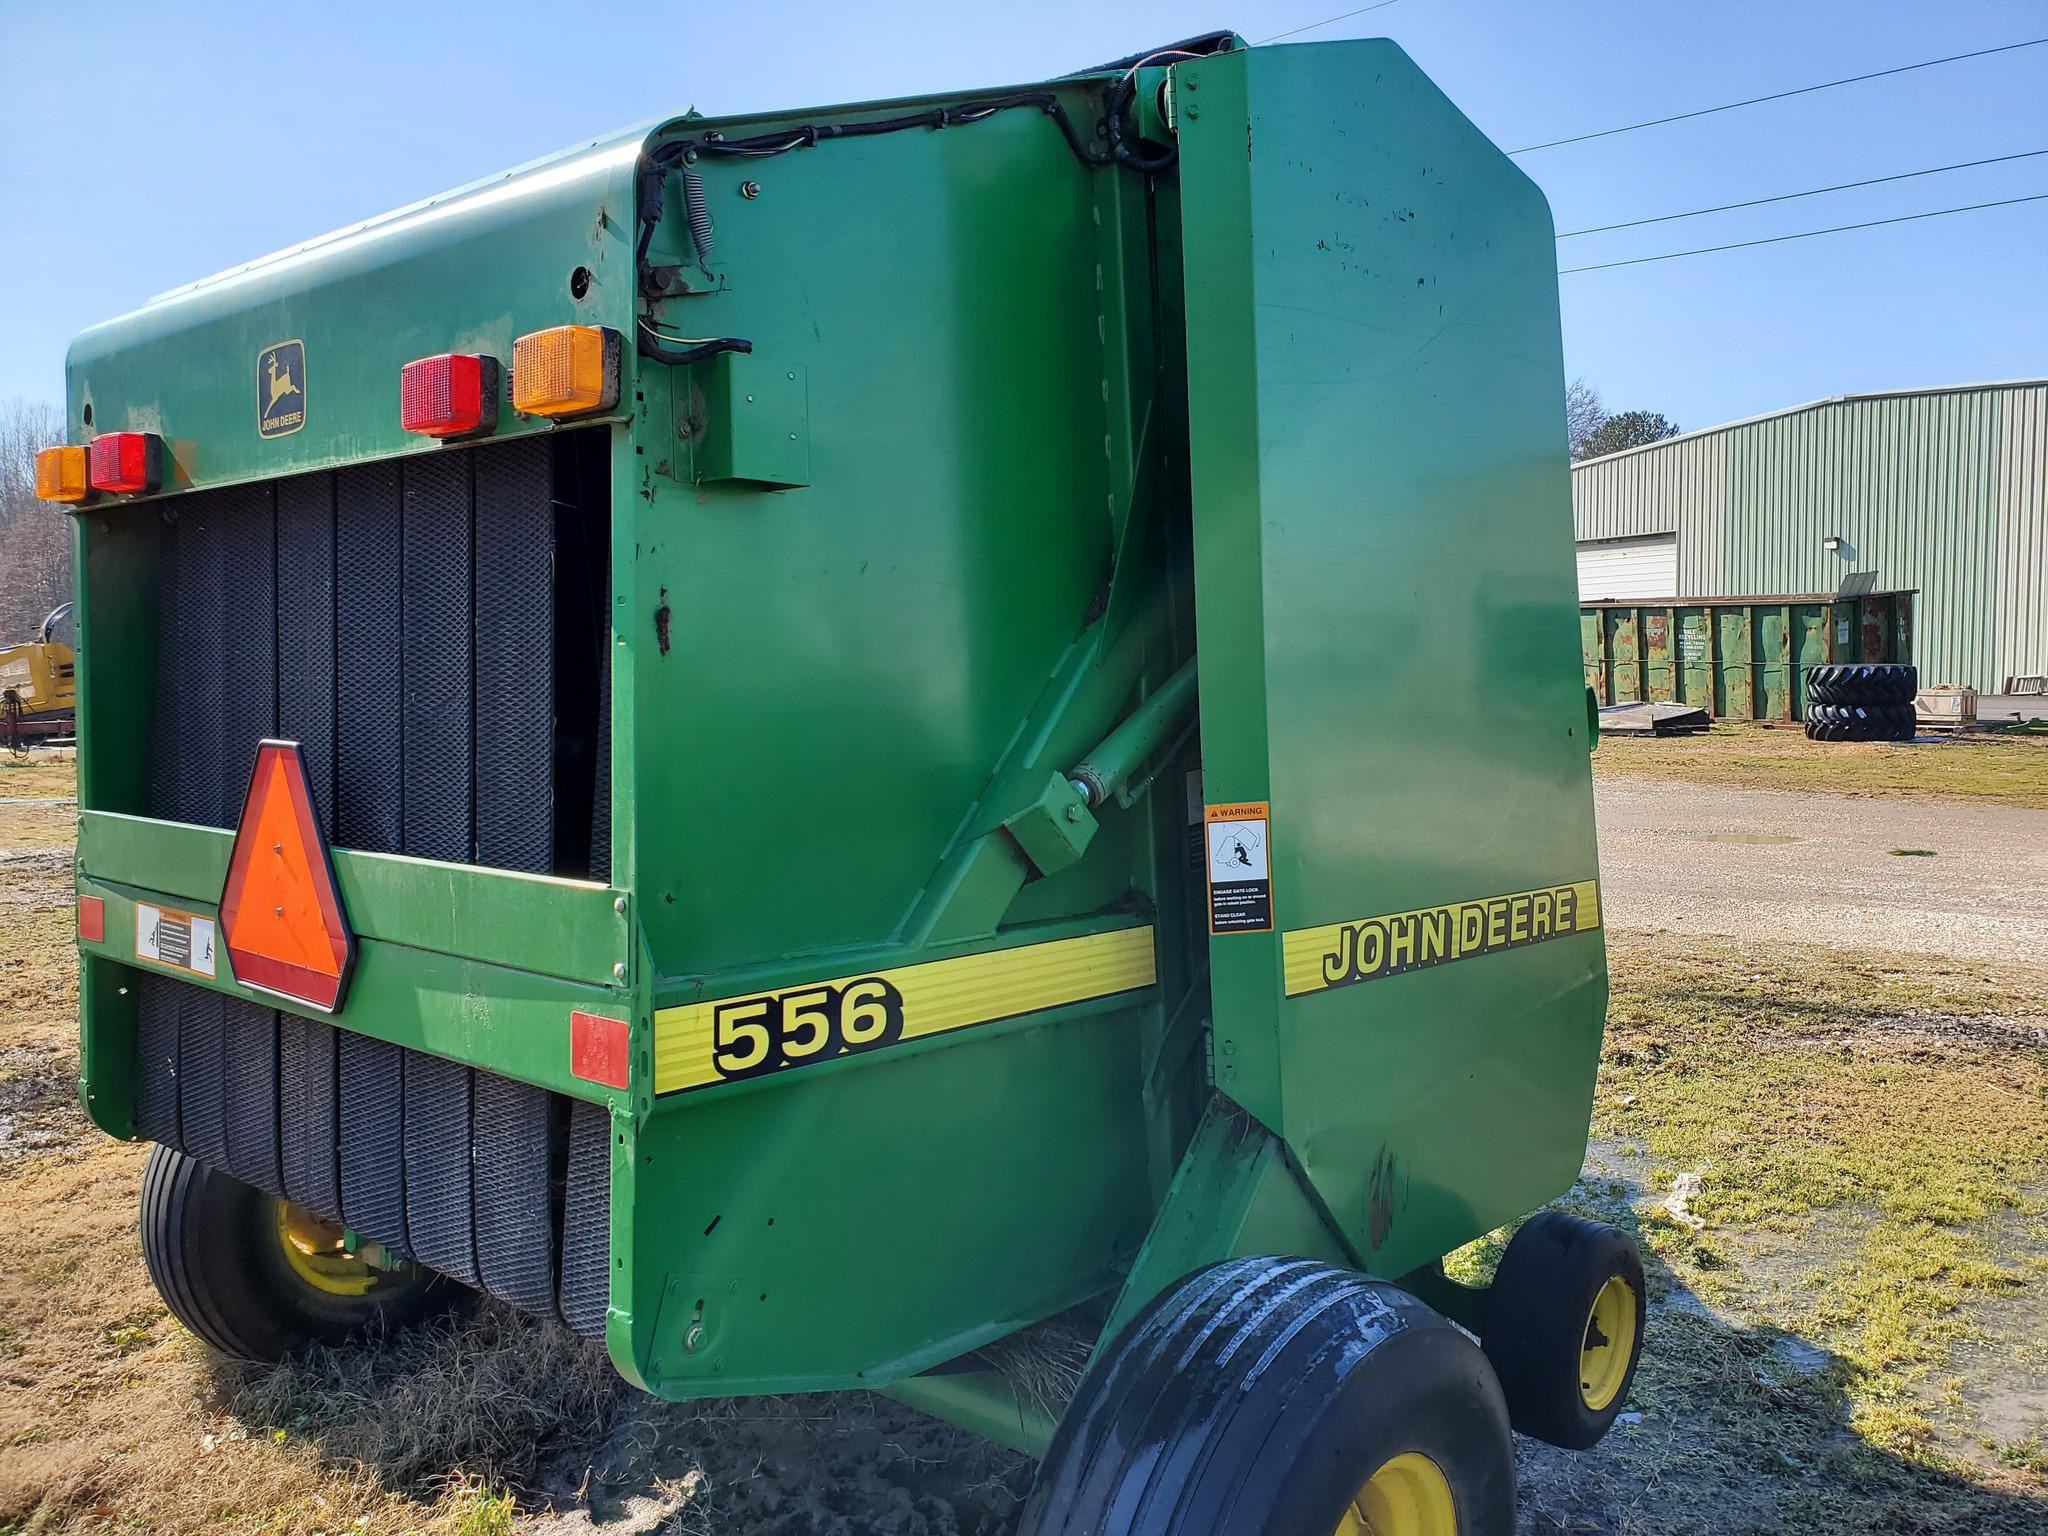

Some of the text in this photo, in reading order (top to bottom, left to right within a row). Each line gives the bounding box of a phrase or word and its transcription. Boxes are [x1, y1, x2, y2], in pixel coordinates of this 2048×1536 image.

[262, 411, 302, 431] JOHN DEERE
[1220, 807, 1263, 817] WARNING
[1324, 889, 1575, 984] JOHN DEERE
[715, 979, 896, 1076] 556
